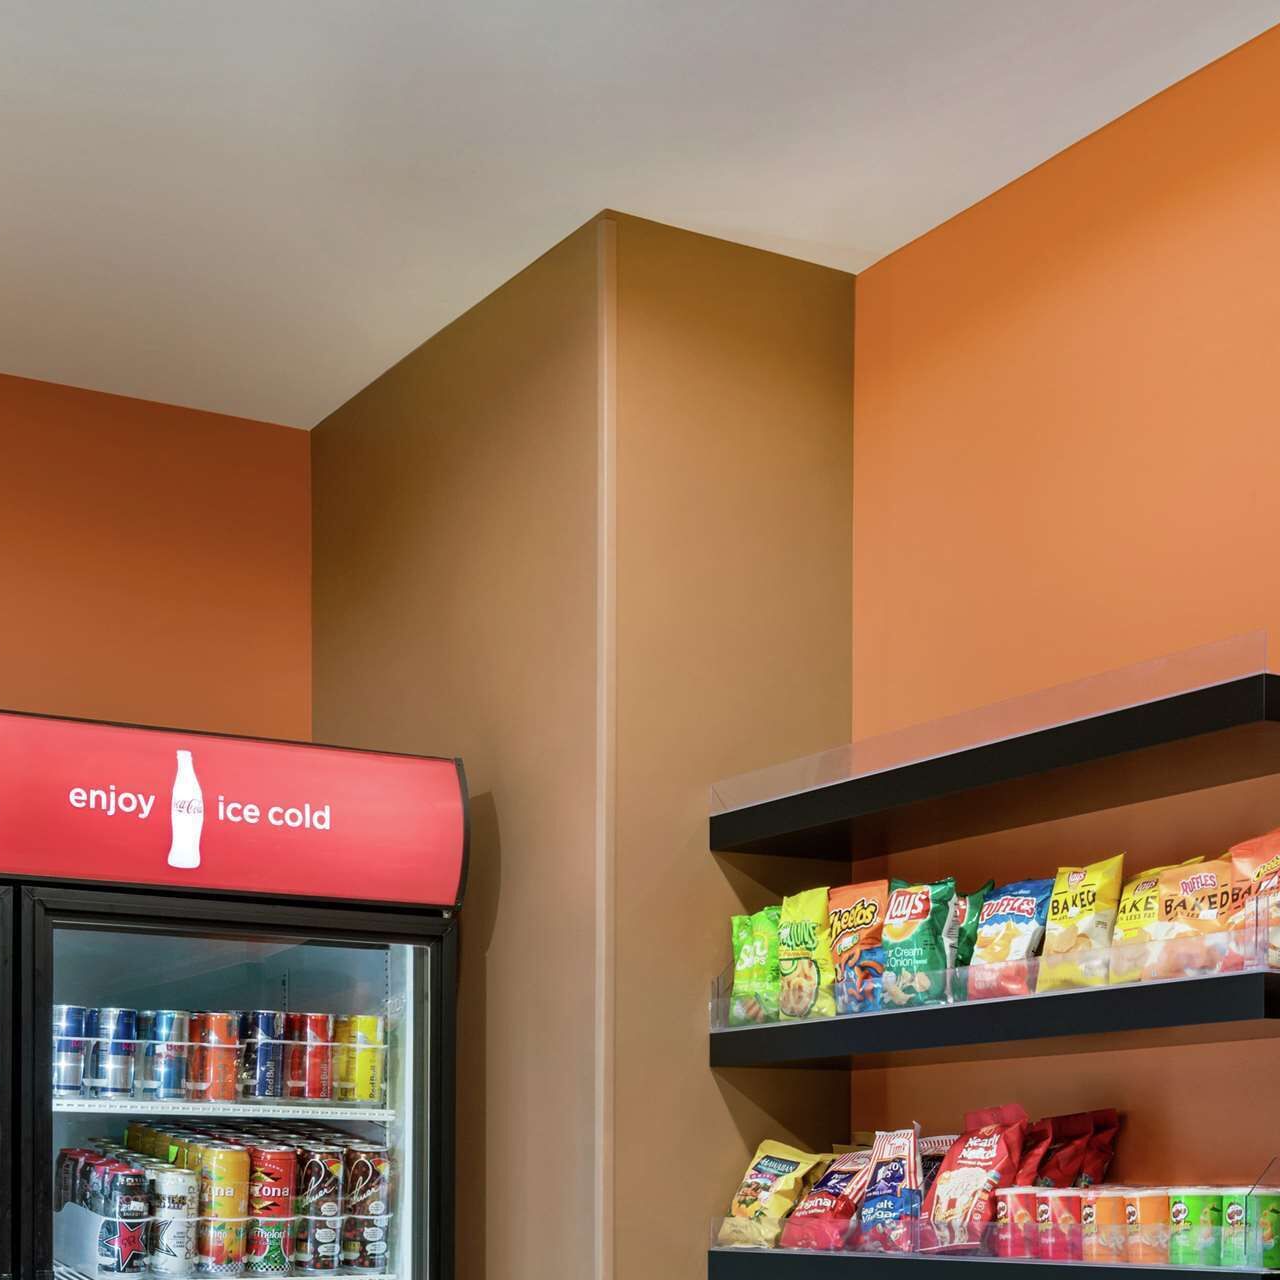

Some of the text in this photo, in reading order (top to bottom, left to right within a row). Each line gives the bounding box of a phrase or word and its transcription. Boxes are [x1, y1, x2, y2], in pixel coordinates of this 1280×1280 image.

[69, 783, 331, 831] enjoy ice cold
[1180, 873, 1217, 896] RUFFLES
[980, 896, 1036, 922] RUFFLES
[1052, 889, 1097, 916] BAKED
[1164, 890, 1229, 916] BAKED
[889, 957, 913, 968] Onion
[894, 946, 923, 958] Cream
[265, 1060, 275, 1096] Red Bull
